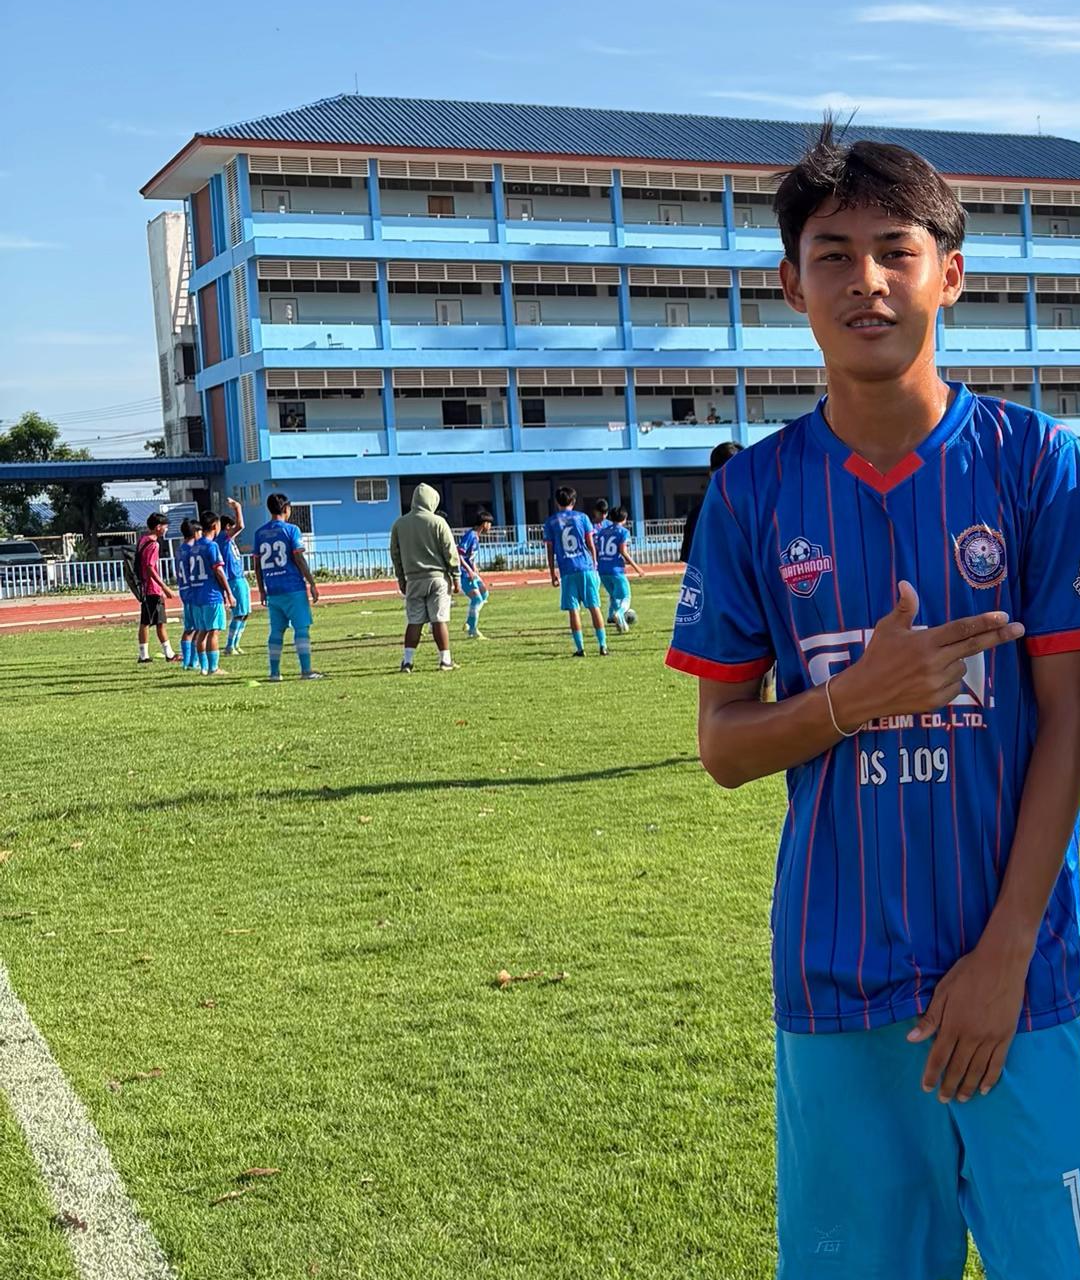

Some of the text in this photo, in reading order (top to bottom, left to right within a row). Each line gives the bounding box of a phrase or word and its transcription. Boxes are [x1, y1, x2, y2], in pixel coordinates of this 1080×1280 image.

[562, 526, 577, 551] 6
[599, 536, 617, 556] 16
[259, 540, 287, 569] 23
[900, 747, 949, 784] 109
